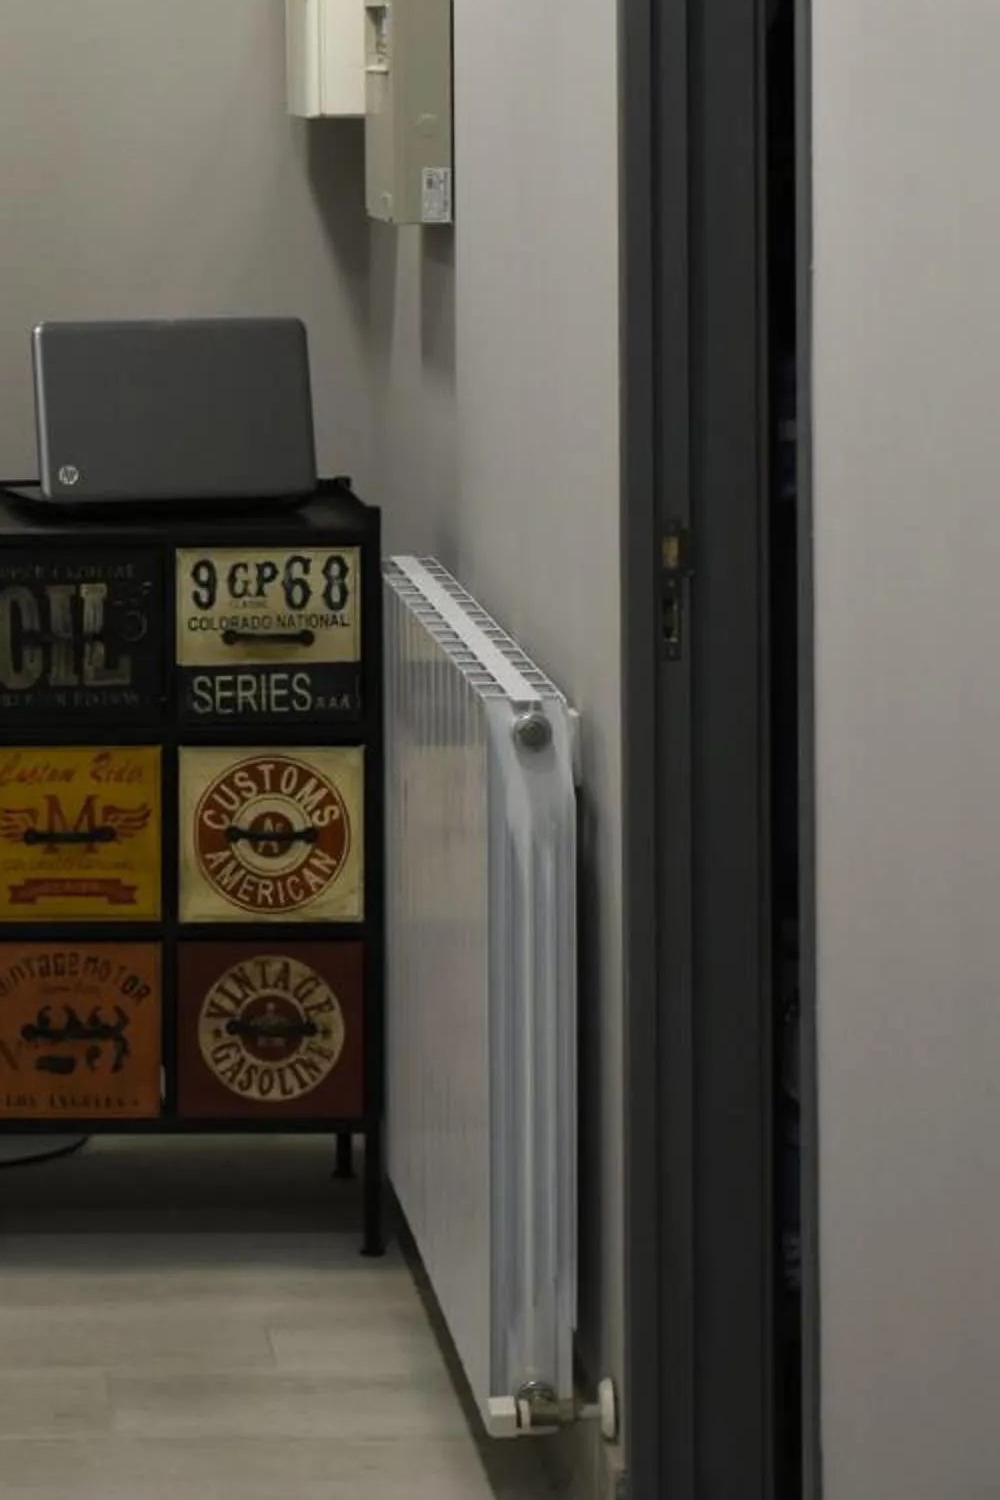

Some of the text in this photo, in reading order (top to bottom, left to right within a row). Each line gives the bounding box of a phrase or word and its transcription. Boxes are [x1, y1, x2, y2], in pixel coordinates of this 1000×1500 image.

[188, 612, 351, 632] COLORADO NATIONAL
[191, 671, 313, 714] SERIES
[203, 763, 341, 831] CUSTOMS
[204, 847, 338, 906] AMERICAN
[204, 959, 338, 1025] VINTAGE
[211, 1040, 335, 1097] GASOLINE
